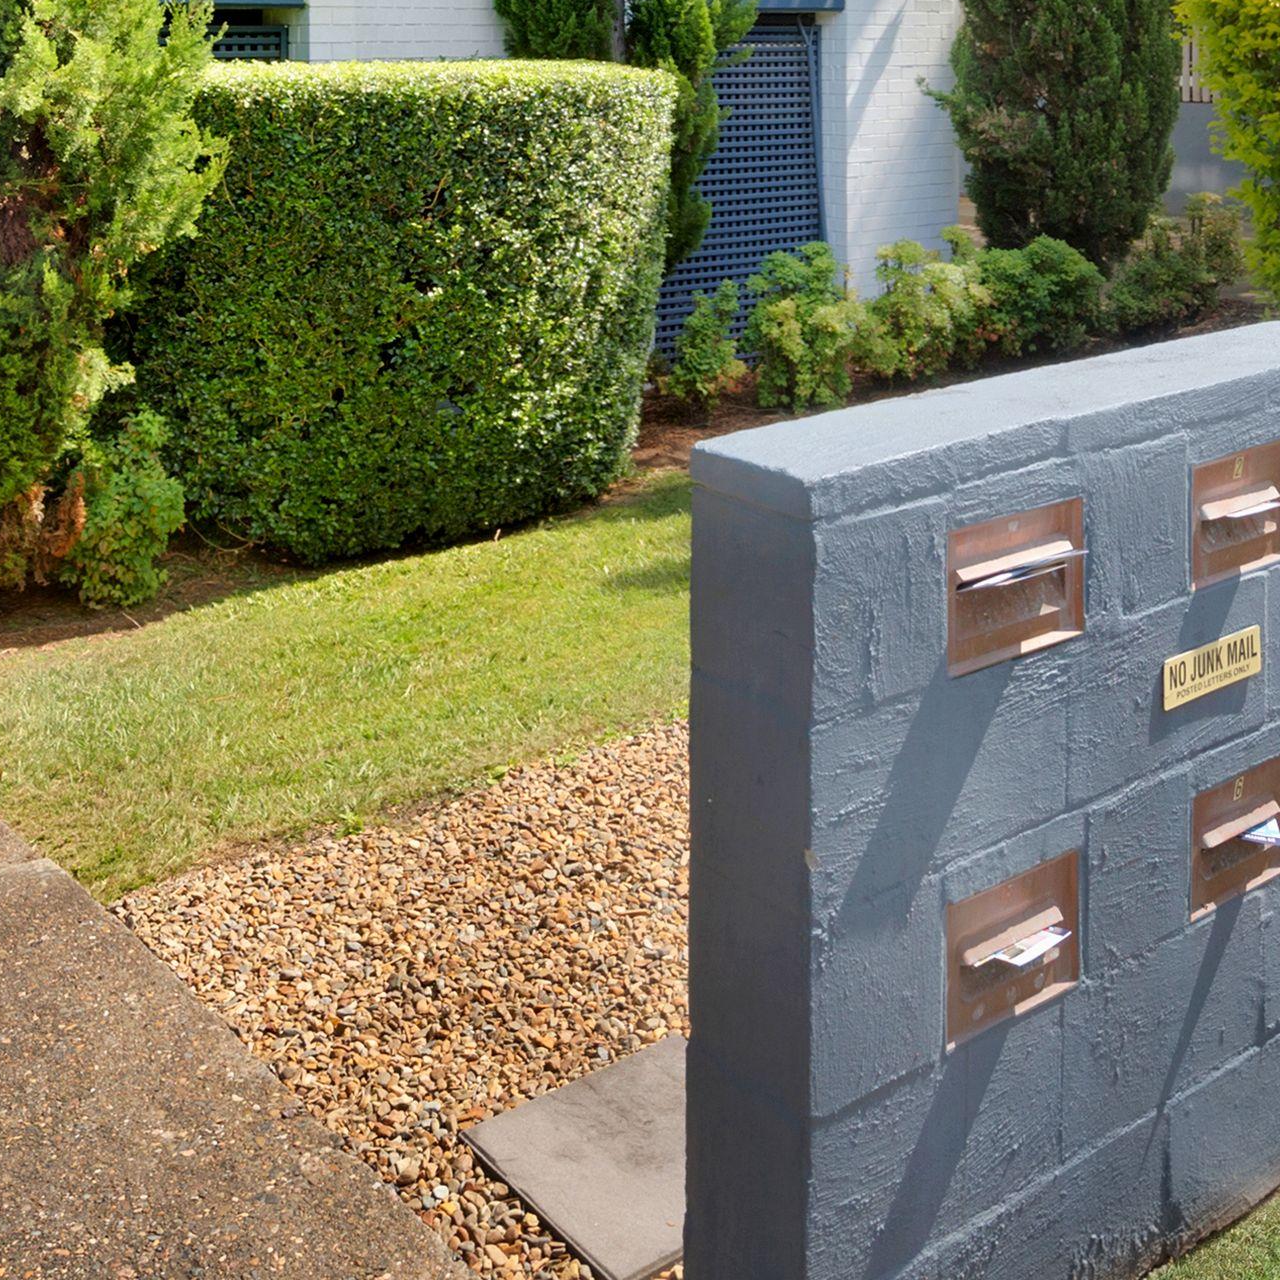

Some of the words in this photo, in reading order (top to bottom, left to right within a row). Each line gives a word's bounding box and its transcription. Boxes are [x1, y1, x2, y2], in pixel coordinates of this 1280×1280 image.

[1234, 457, 1244, 479] 2
[1169, 661, 1187, 690] NO
[1190, 646, 1224, 681] JUNK
[1227, 634, 1257, 666] MAIL
[1176, 681, 1203, 700] POSTED
[1203, 671, 1233, 691] LETTERS
[1233, 663, 1251, 681] ONLY
[1234, 776, 1245, 800] 6
